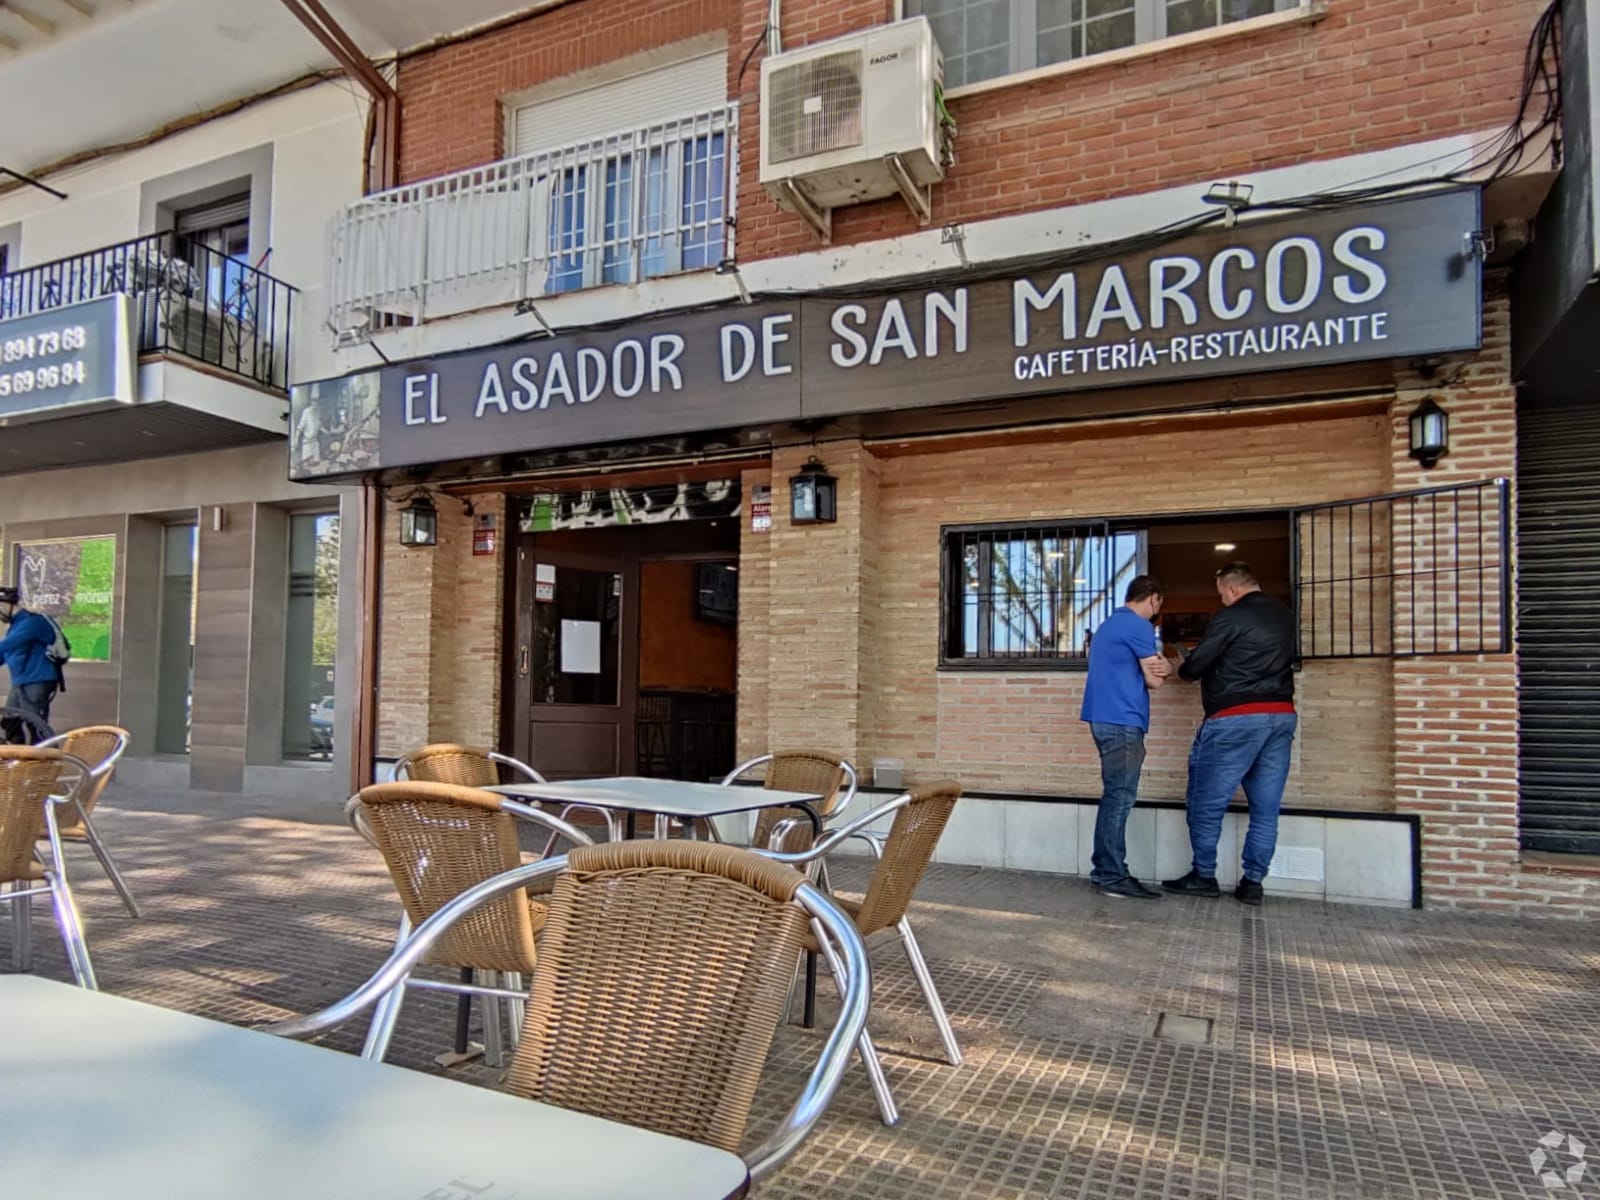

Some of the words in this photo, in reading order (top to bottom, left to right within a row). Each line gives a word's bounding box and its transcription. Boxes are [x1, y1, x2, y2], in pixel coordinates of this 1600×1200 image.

[870, 53, 898, 65] FAGOR
[404, 372, 448, 426] EL
[474, 333, 685, 418] ASADOR
[720, 313, 794, 383] DE
[830, 287, 968, 368] SAN
[1013, 226, 1388, 348] MARCOS
